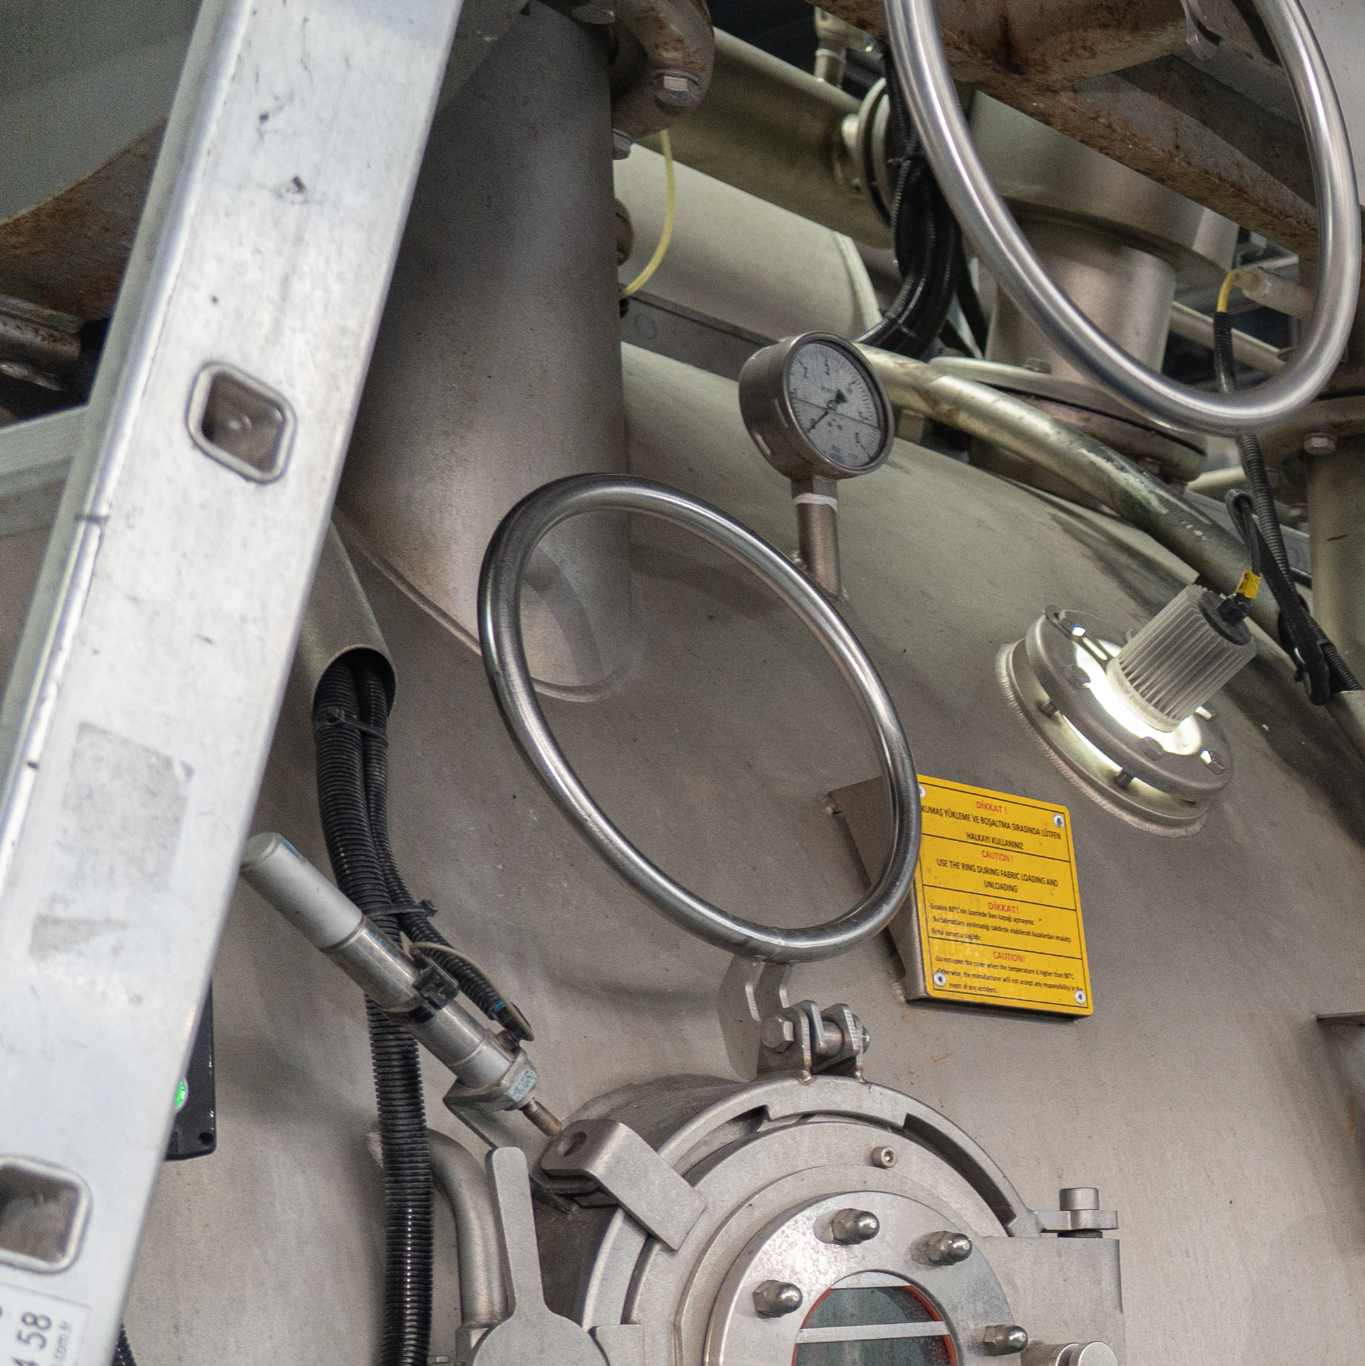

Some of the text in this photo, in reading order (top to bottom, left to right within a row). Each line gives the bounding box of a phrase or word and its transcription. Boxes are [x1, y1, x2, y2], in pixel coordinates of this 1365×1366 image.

[976, 800, 1003, 813] DİKKAT
[982, 850, 1010, 862] CAUTION
[937, 859, 1058, 887] USE THE RING DURING FABRIC LOADING AND
[984, 881, 1018, 893] UNLOADING
[988, 901, 1019, 914] DİKKAT!
[993, 951, 1026, 962] CAUTION!
[15, 1311, 52, 1351] 58
